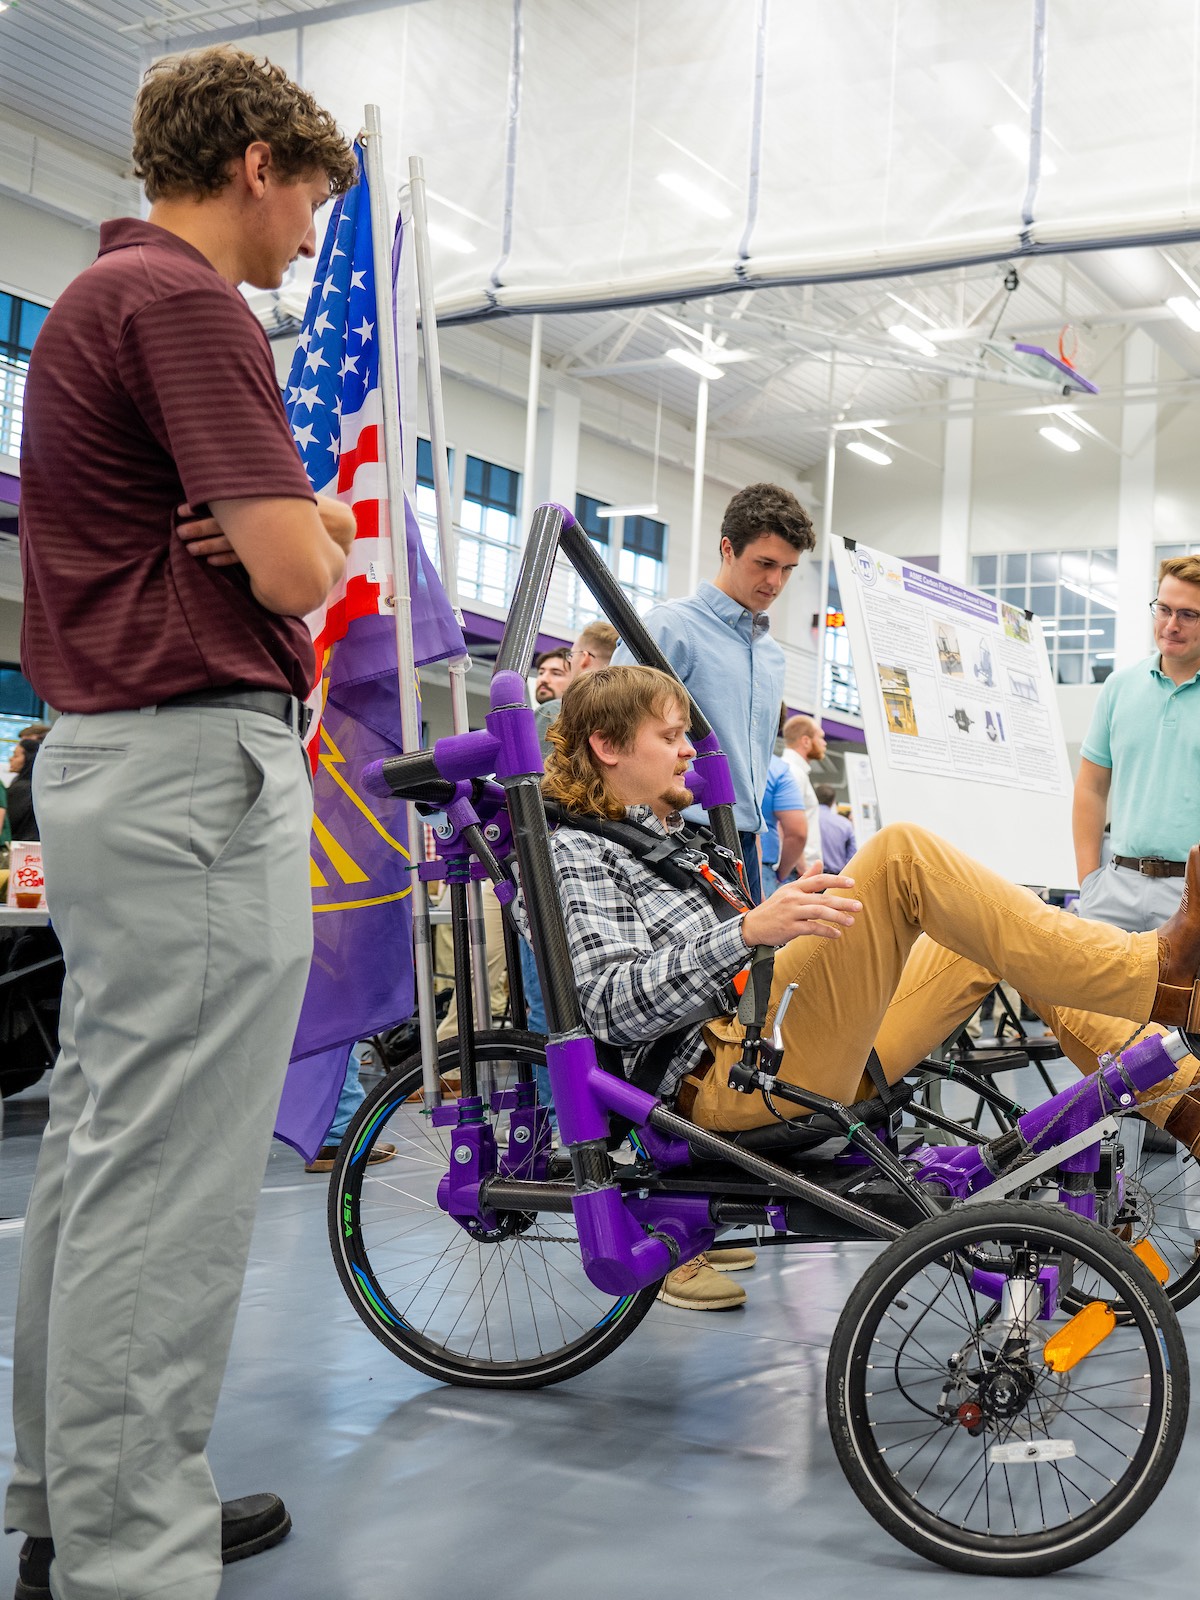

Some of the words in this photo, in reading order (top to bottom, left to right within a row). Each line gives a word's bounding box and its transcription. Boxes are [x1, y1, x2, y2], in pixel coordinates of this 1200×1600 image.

[18, 868, 38, 879] POP
[344, 1193, 353, 1237] USA
[1121, 1270, 1159, 1325] SCHWALBE
